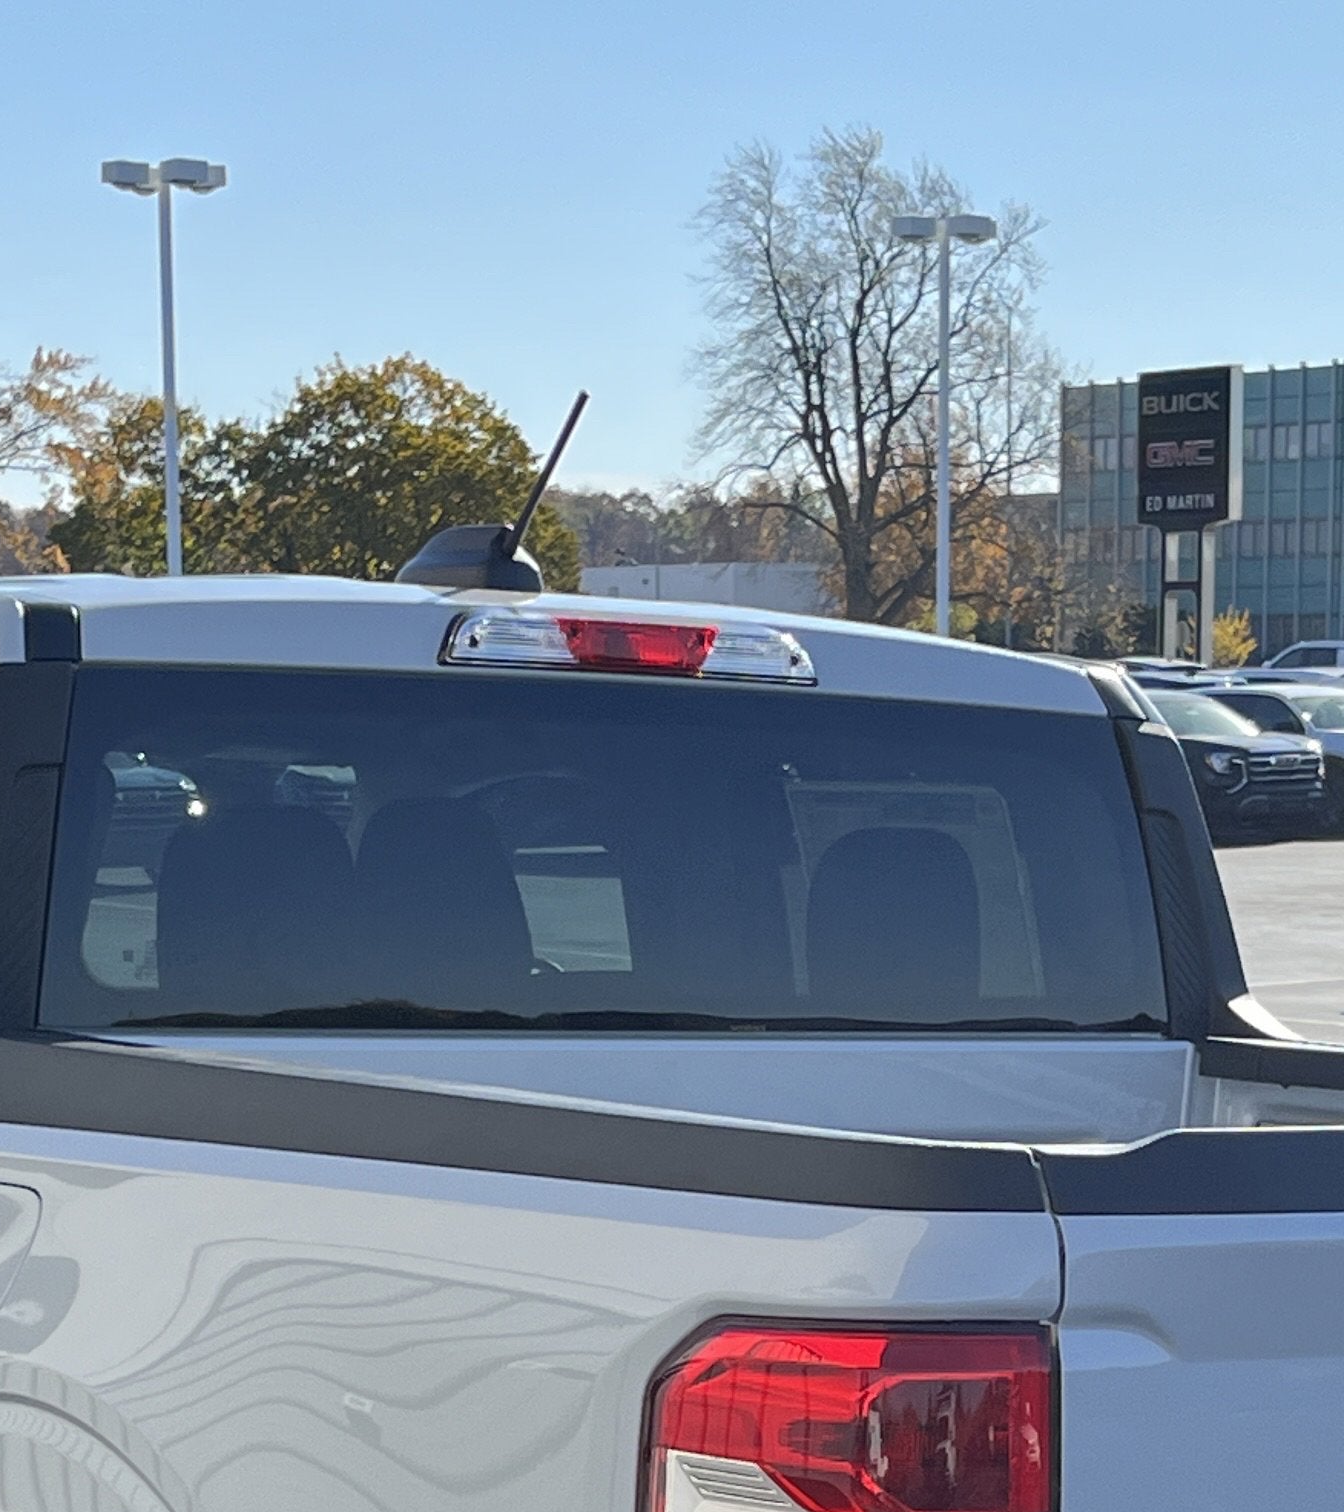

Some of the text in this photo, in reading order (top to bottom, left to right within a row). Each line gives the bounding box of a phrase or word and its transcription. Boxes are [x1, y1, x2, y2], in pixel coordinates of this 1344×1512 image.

[1142, 391, 1221, 415] BUICK
[1146, 439, 1215, 468] GMC
[1145, 493, 1215, 512] ED MARTIN
